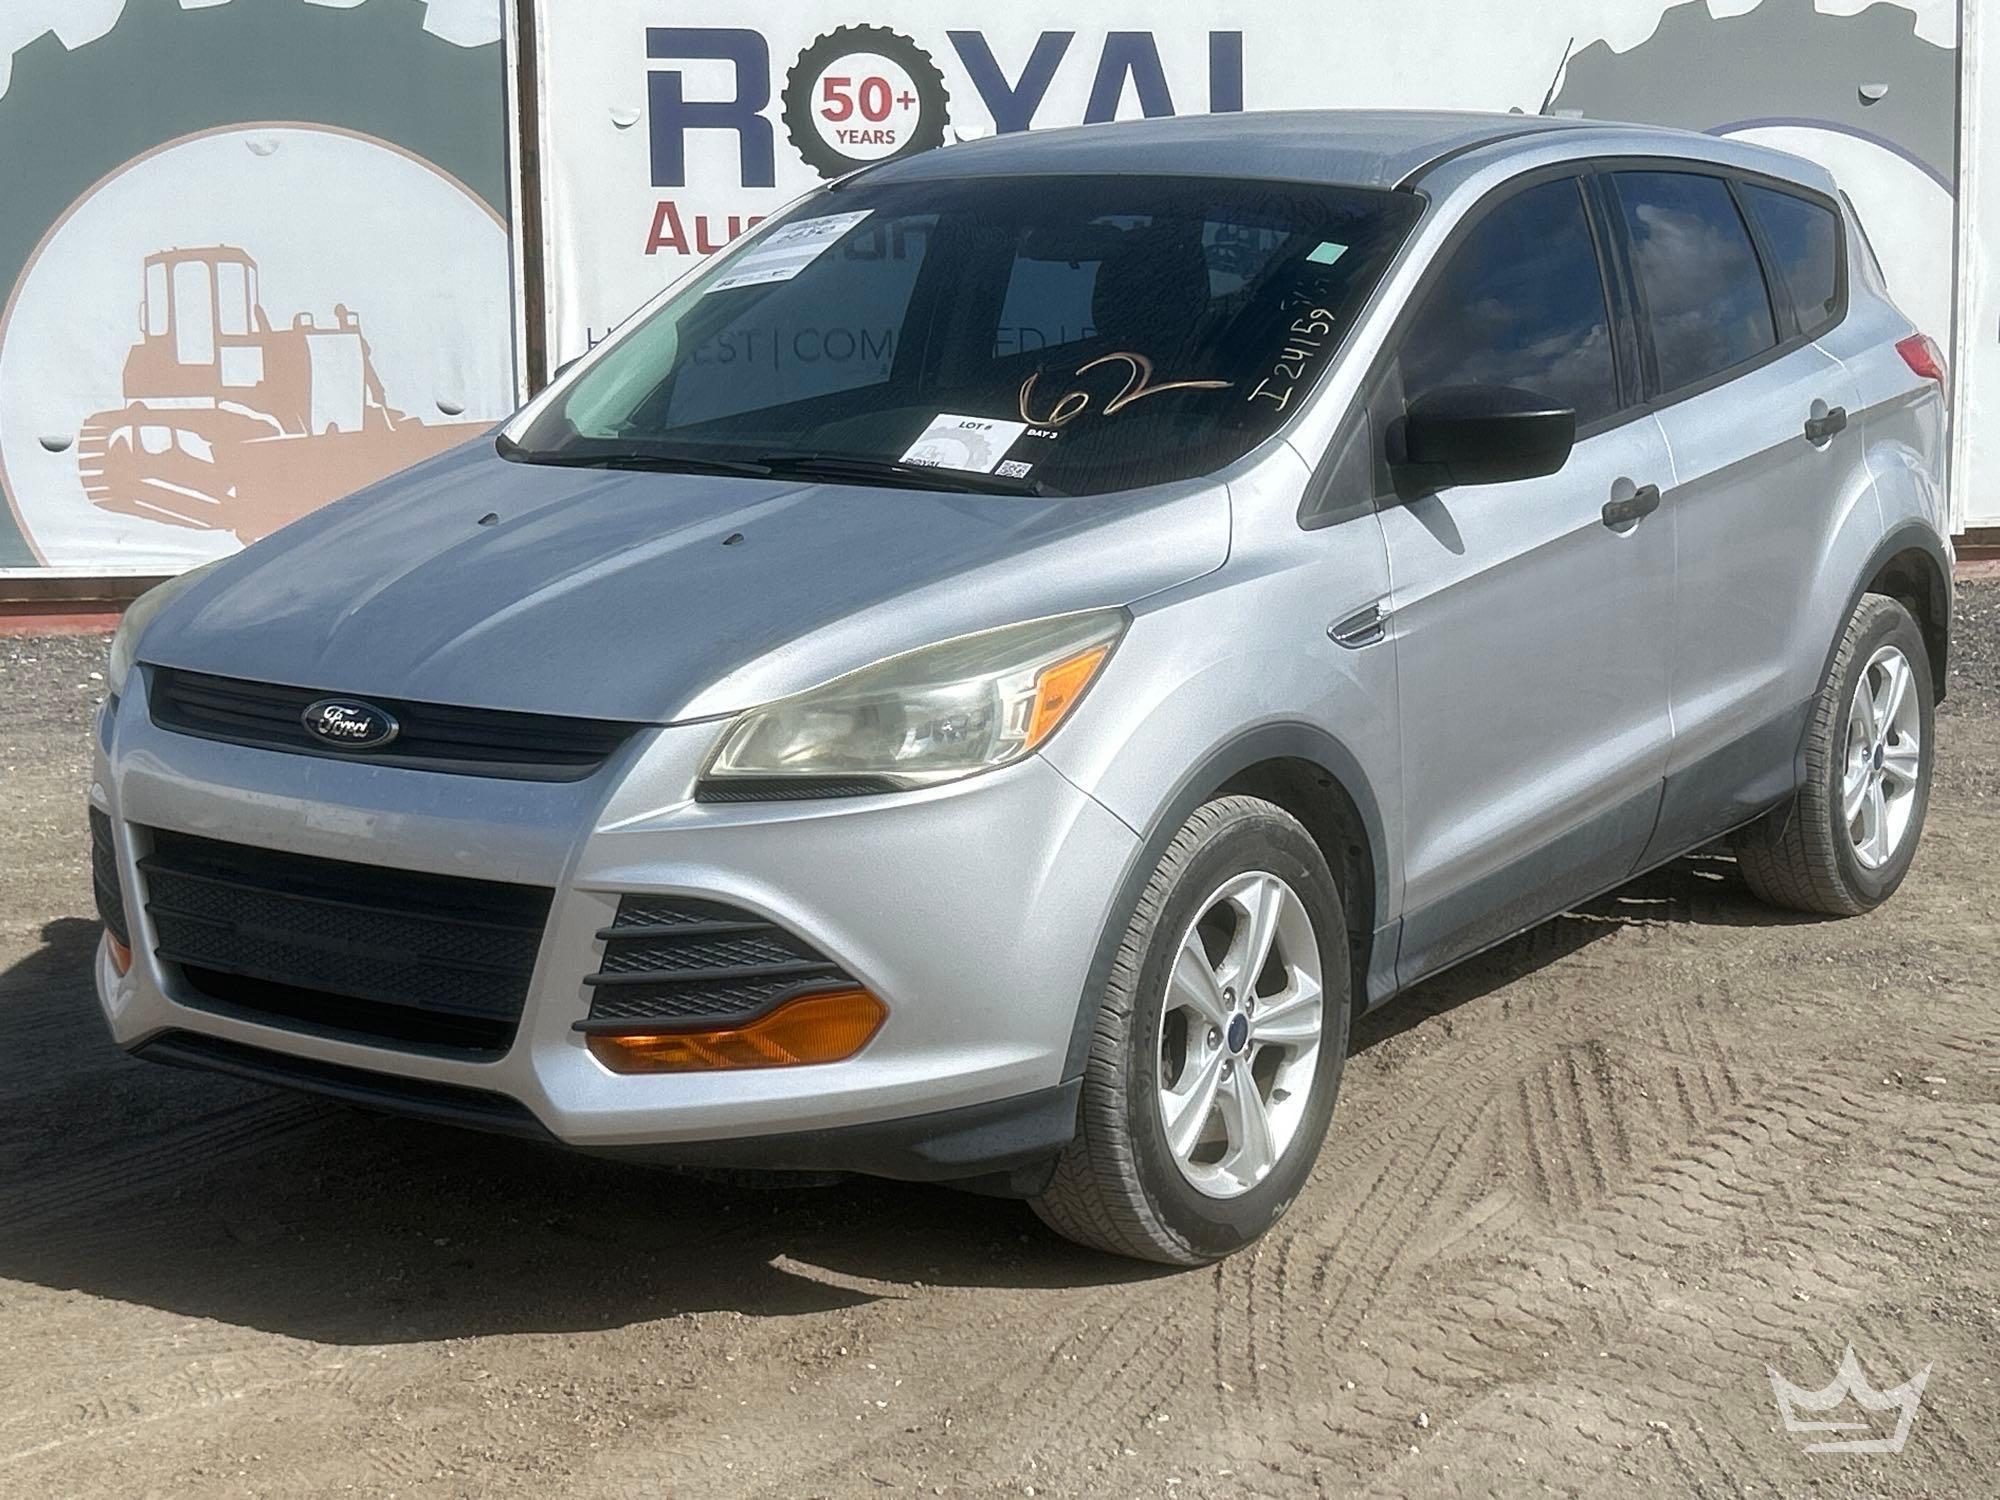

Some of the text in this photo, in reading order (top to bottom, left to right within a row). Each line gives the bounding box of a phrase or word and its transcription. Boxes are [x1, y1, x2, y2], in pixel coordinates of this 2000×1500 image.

[820, 76, 916, 122] 50+
[835, 129, 896, 145] YEARS
[1019, 352, 1235, 427] 62
[958, 421, 984, 431] LOT
[1026, 428, 1050, 438] DAY
[319, 705, 372, 738] Ford
